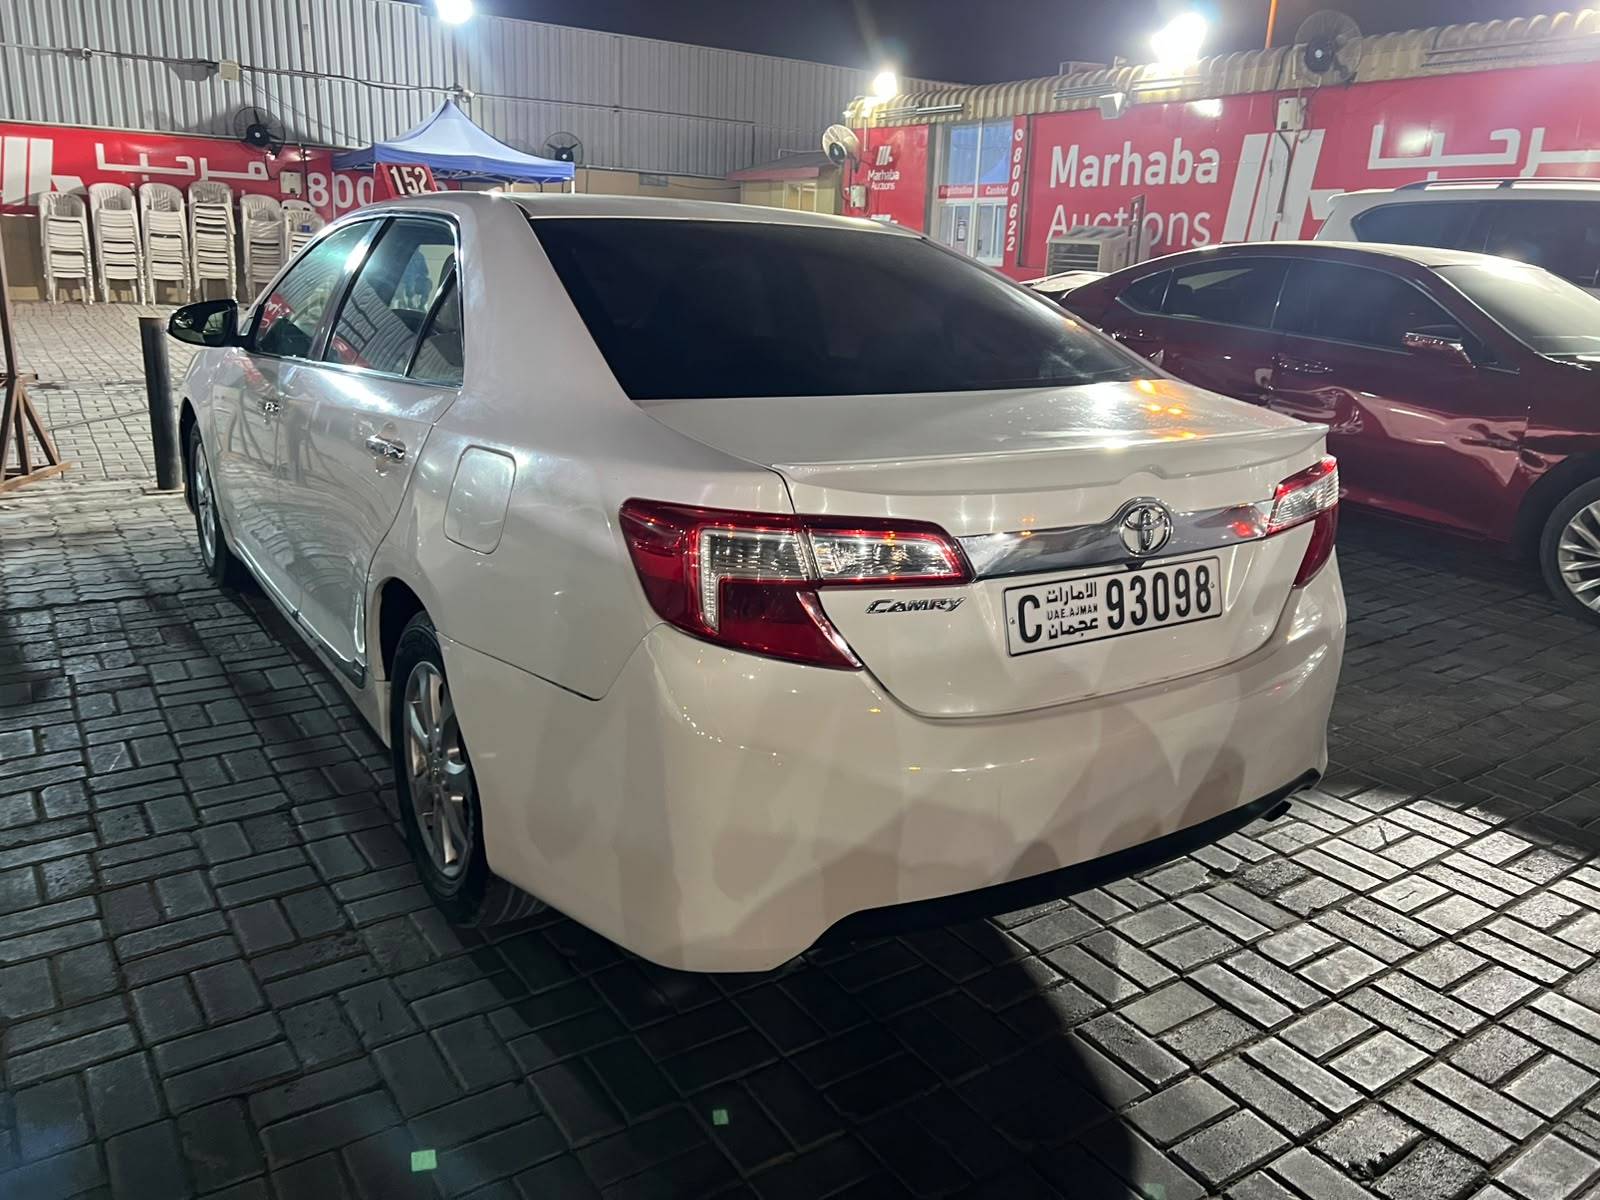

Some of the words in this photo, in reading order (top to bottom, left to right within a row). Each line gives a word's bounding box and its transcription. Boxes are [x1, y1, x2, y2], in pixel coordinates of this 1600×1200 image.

[95, 142, 269, 182] مرحبا
[1050, 137, 1220, 189] Marhaba
[1367, 123, 1600, 181] رحبا
[307, 171, 374, 208] 800
[390, 165, 432, 196] 152
[867, 169, 900, 181] Marhaba
[870, 181, 896, 191] Auctions
[1011, 147, 1022, 197] 800
[1006, 203, 1018, 251] 622
[1046, 204, 1211, 247] Atons
[865, 596, 967, 615] CAMRY
[1018, 594, 1042, 644] C
[1105, 565, 1212, 631] 93098
[1046, 581, 1097, 605] الامارات
[1048, 617, 1099, 640] عجمان
